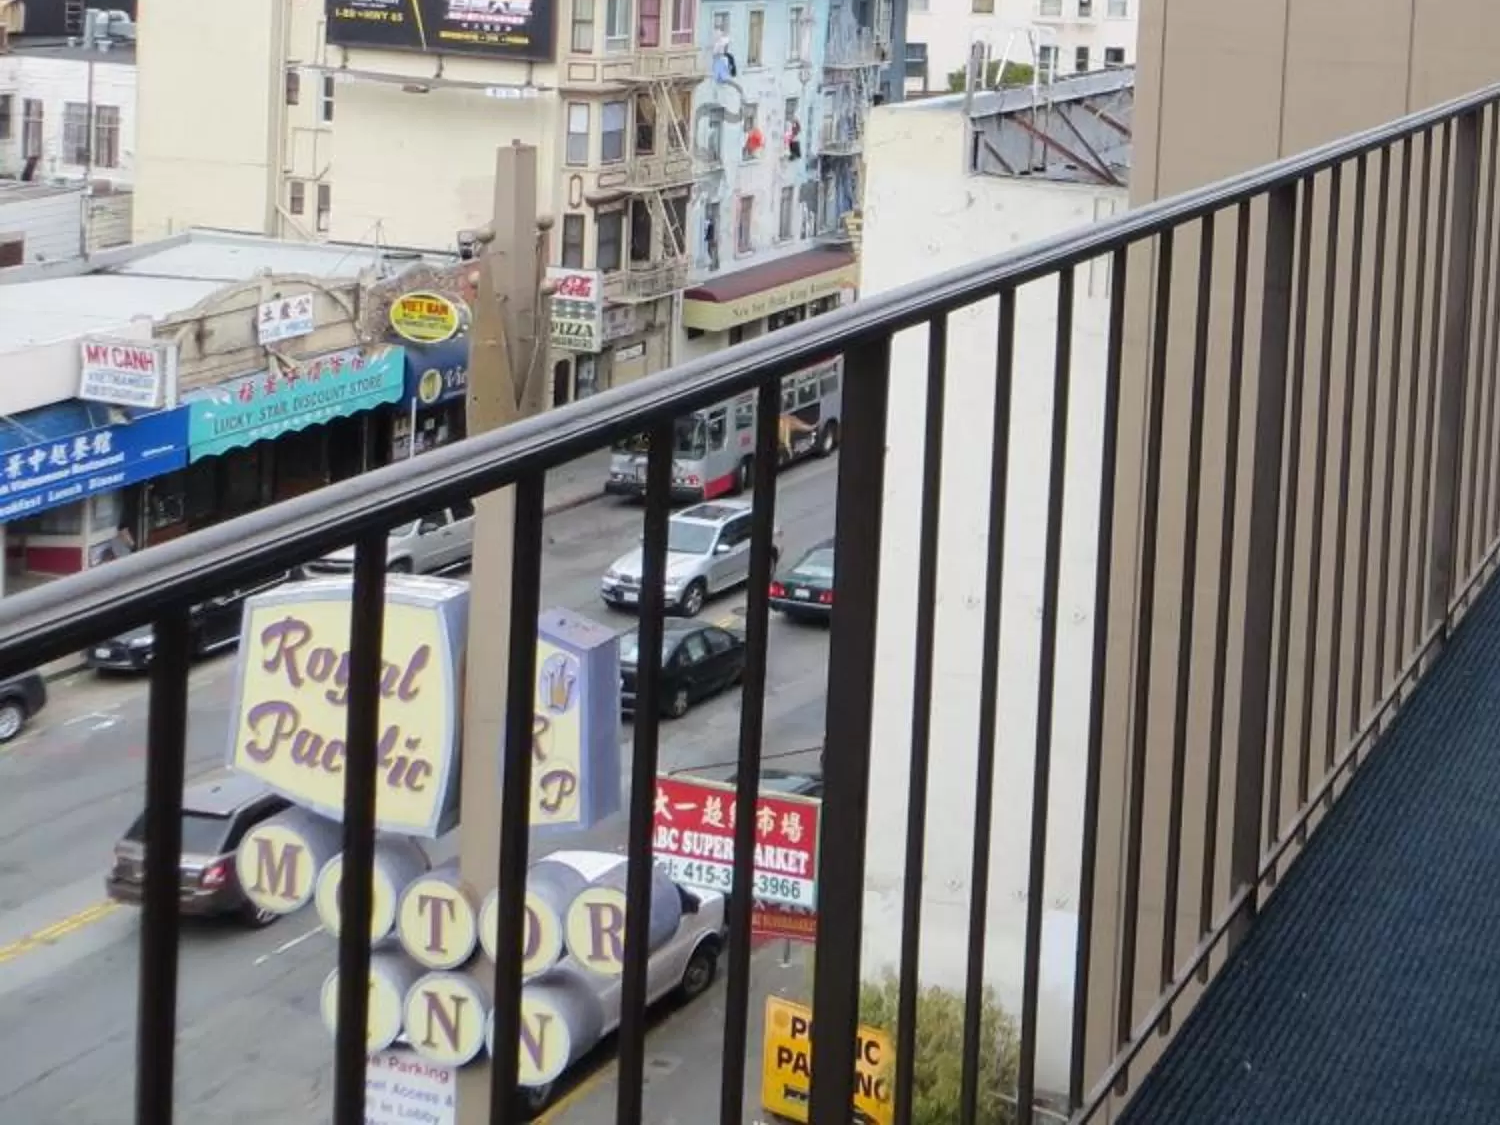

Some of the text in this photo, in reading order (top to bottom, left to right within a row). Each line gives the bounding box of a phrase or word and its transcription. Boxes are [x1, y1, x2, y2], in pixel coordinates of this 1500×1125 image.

[551, 322, 594, 337] PIZZA
[87, 345, 155, 372] MY CANH
[213, 412, 252, 435] LUCKY
[259, 399, 289, 422] STAR
[293, 384, 346, 413] DISCOUNT
[350, 373, 383, 396] STORE
[47, 482, 83, 502] Lunch
[539, 769, 577, 813] P
[682, 829, 809, 874] SUPERARKET
[683, 861, 801, 900] 415-3-3966
[791, 1015, 881, 1066] PIC
[388, 1055, 449, 1085] Parking
